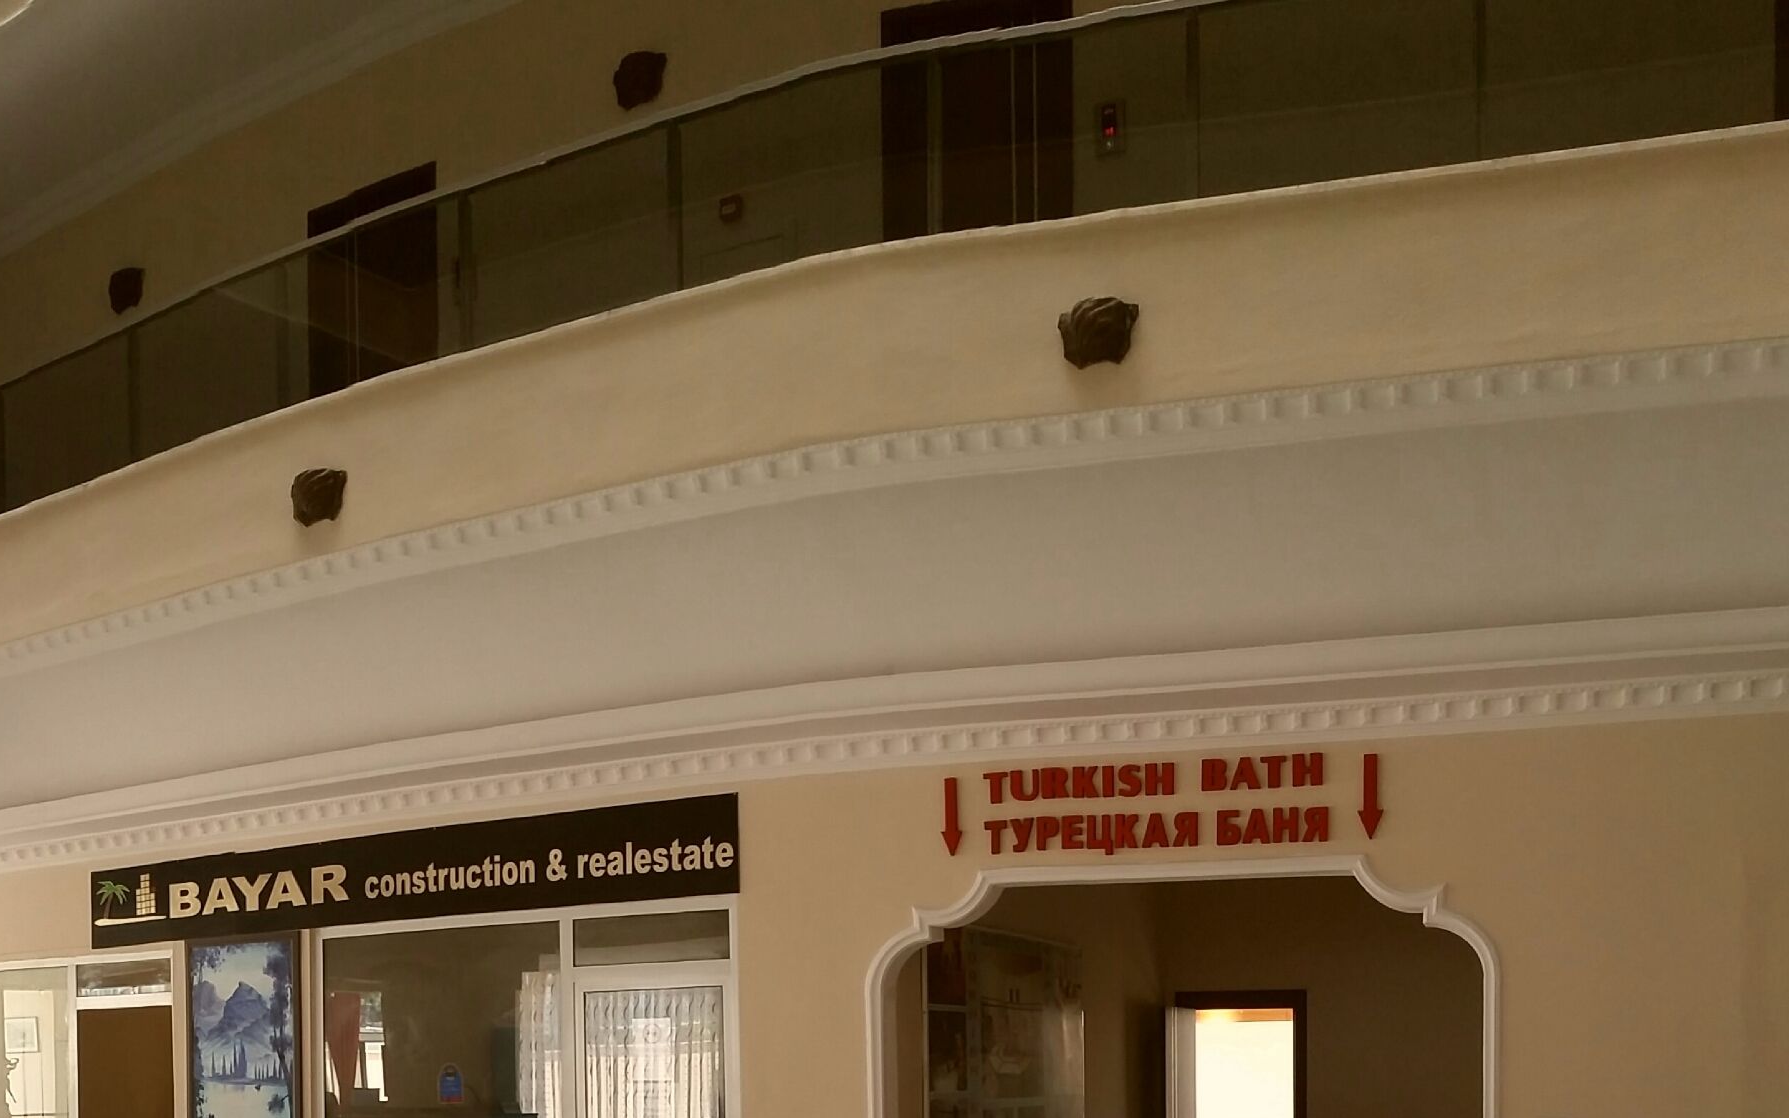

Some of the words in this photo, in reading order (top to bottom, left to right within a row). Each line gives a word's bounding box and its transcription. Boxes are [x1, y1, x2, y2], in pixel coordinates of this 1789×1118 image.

[983, 762, 1175, 804] TURKISH
[1201, 752, 1324, 792] BATH
[984, 811, 1199, 855] ТУРЕЦКАЯ
[1216, 806, 1329, 846] БАНЯ
[168, 864, 349, 920] BAYAR
[364, 854, 537, 900] construction
[546, 848, 569, 882] &
[577, 835, 735, 879] realestate
